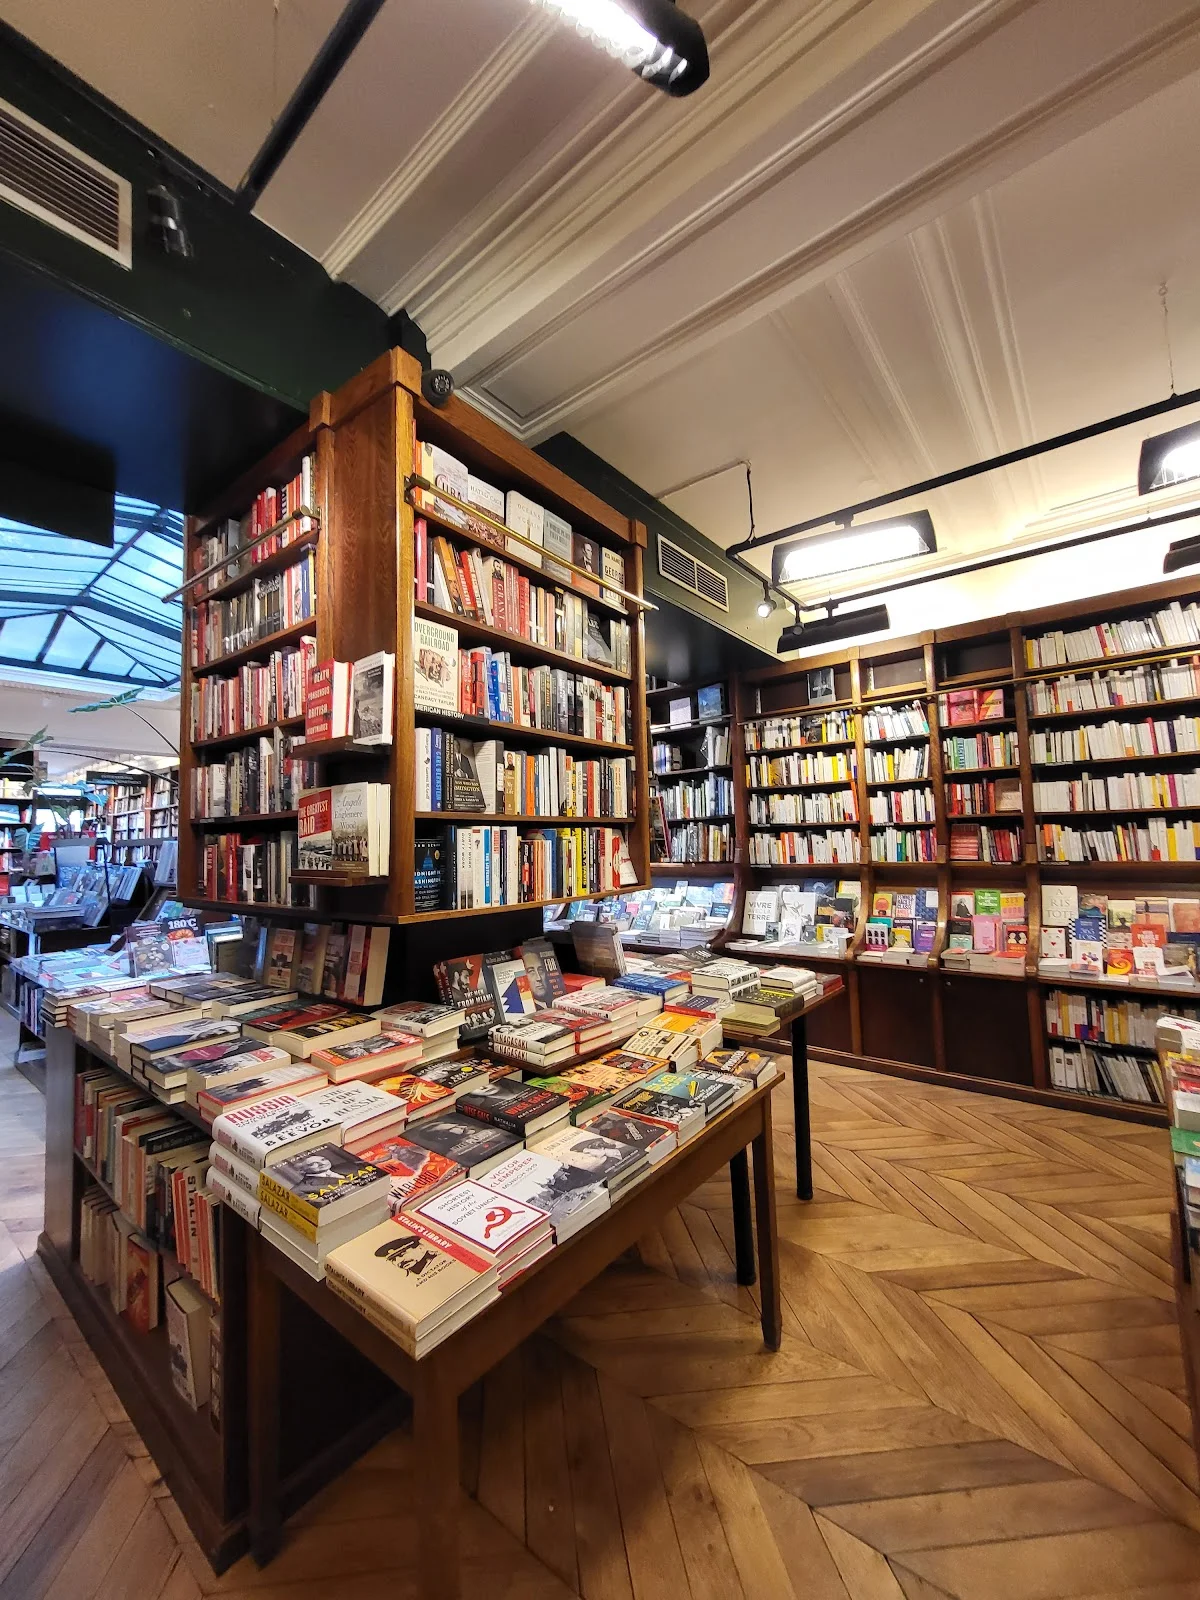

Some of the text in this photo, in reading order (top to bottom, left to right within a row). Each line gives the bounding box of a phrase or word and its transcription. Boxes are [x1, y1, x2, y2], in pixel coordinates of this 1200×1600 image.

[604, 566, 624, 582] GEORGE
[414, 622, 454, 642] OVERGROUND
[420, 635, 450, 652] RAILROAD
[414, 704, 465, 720] MERICAN HISTORY
[307, 800, 328, 816] GREATEST
[299, 816, 315, 836] RAID
[1046, 909, 1074, 918] TOTE
[544, 958, 557, 972] FDR
[457, 999, 474, 1008] FROM
[500, 1034, 528, 1050] NAGASAKI
[500, 1045, 528, 1061] NAGASAKI
[319, 1088, 362, 1107] STORY
[321, 1089, 346, 1098] THE
[503, 1091, 552, 1115] WISE GALS
[224, 1095, 296, 1124] RUSSIA
[334, 1095, 384, 1116] RUSSIA
[464, 1105, 490, 1120] WISE GALS
[518, 1103, 545, 1118] NATHALIA
[494, 1116, 516, 1128] NATHALIA
[264, 1118, 331, 1146] BEEVOR
[271, 1161, 287, 1169] TOM
[489, 1160, 519, 1180] VICTOR
[490, 1157, 533, 1188] KLEMPERER
[261, 1174, 290, 1202] SALAZAR
[308, 1166, 377, 1200] SALAZAR
[388, 1171, 439, 1200] WARLORD
[502, 1172, 526, 1190] MUNICH
[188, 1176, 197, 1237] STALIN
[260, 1191, 288, 1216] SALAZAR
[437, 1189, 471, 1210] SHORTEST
[446, 1193, 475, 1212] HISTORY
[452, 1210, 476, 1226] SOVIET
[476, 1195, 498, 1211] UNION
[398, 1216, 452, 1248] STALIN'S LIBRARY
[416, 1278, 428, 1287] AND
[438, 1259, 457, 1273] BOOKS
[421, 1260, 448, 1277] DICTATOR
[348, 1278, 365, 1297] LIBRARY
